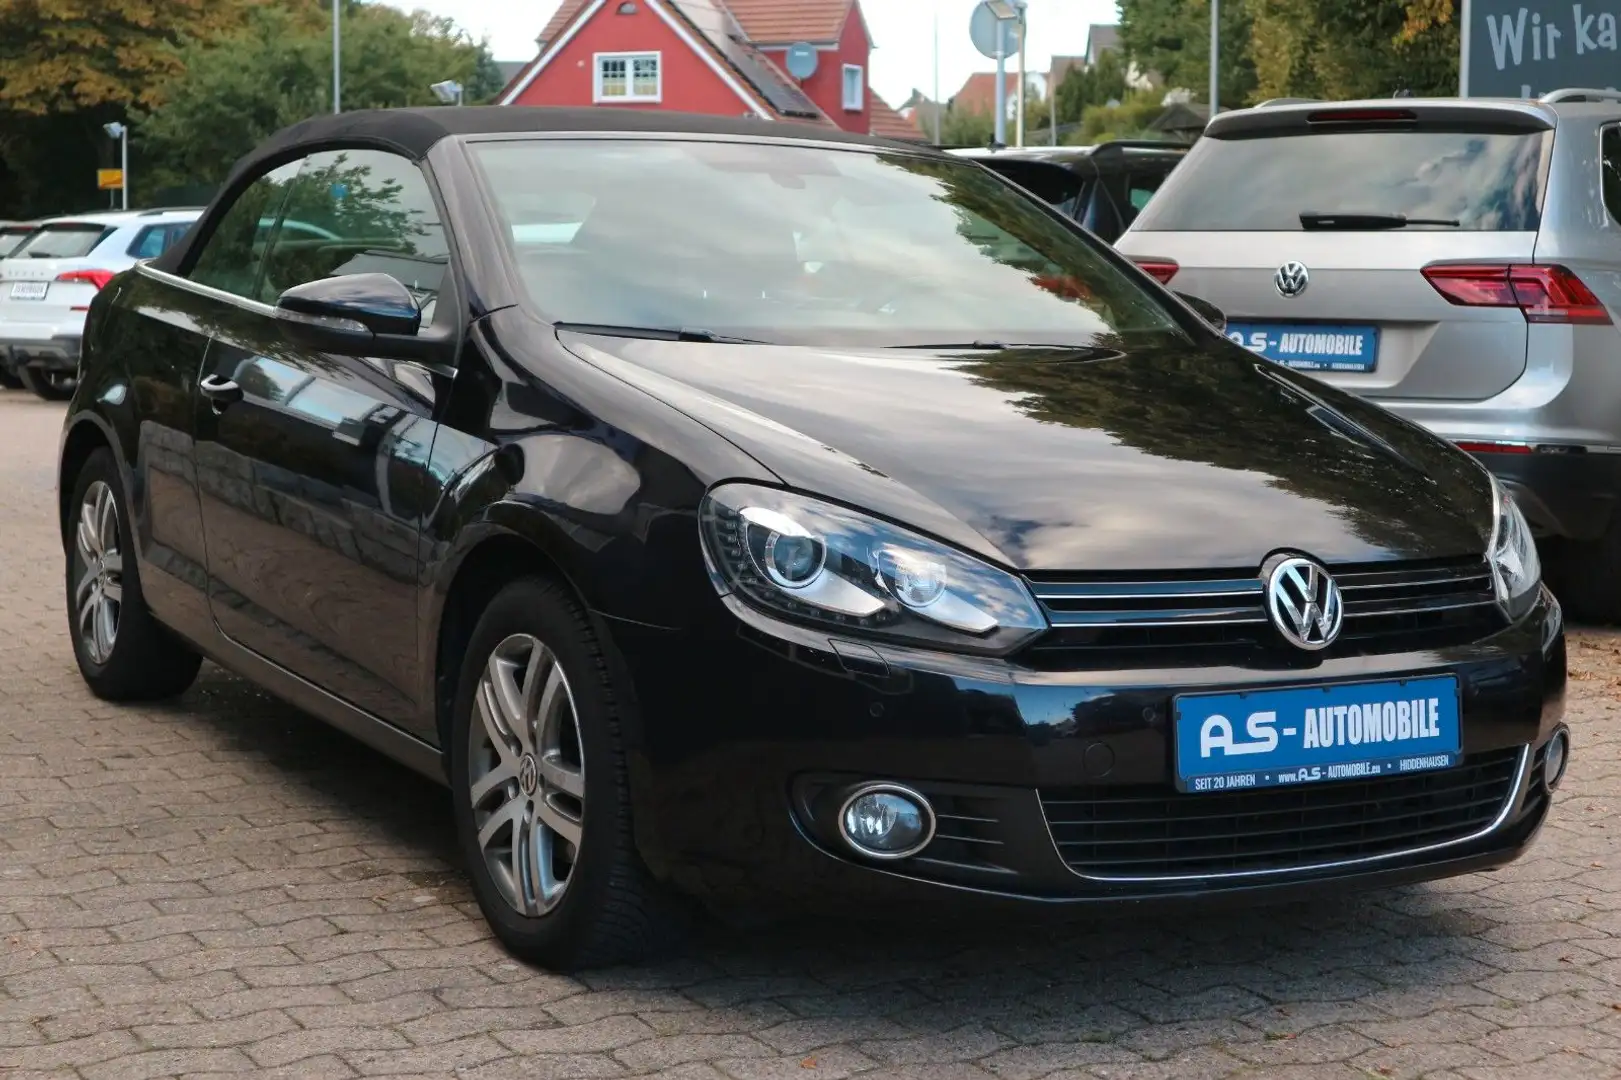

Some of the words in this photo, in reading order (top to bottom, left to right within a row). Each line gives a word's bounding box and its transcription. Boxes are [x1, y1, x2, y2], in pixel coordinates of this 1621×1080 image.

[1486, 7, 1562, 71] Wir
[1572, 3, 1621, 55] ka
[1195, 777, 1212, 790] SEIT
[1213, 777, 1225, 789] 20
[1226, 773, 1256, 788] JAHREN
[1399, 754, 1449, 771] HIDDENHAUSEN
